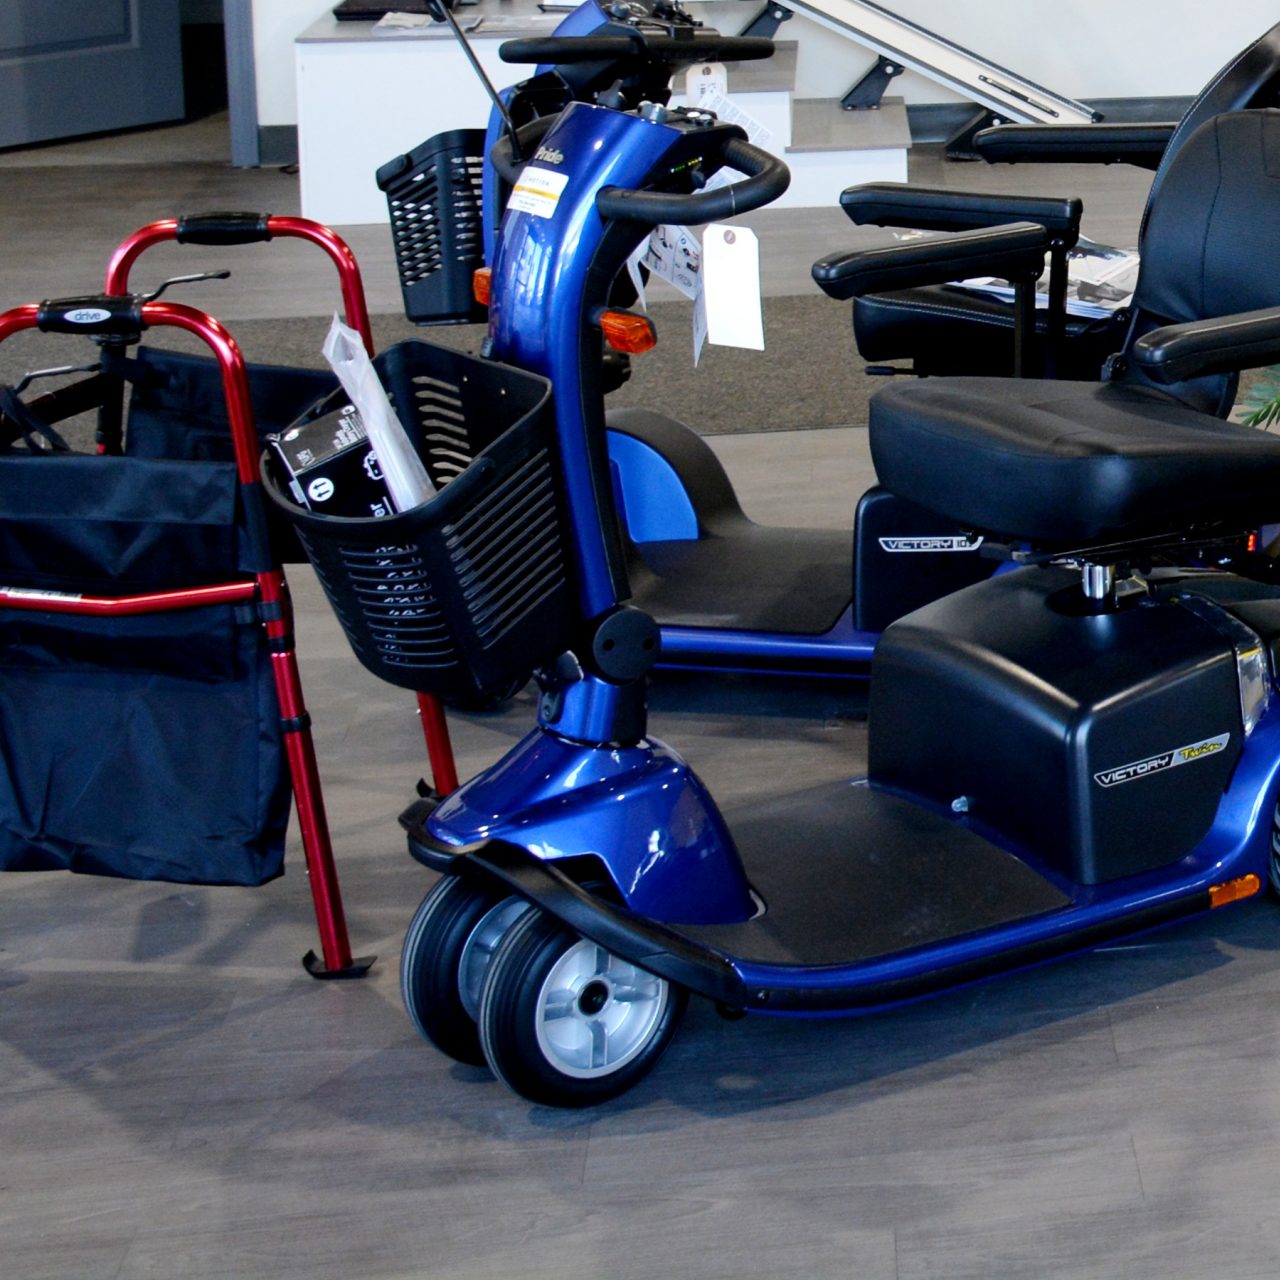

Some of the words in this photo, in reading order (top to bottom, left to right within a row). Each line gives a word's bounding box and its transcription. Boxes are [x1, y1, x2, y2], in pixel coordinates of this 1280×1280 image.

[534, 145, 565, 165] Pride
[74, 311, 101, 321] drive
[888, 540, 951, 549] VICTORY
[1101, 756, 1169, 783] VICTORY
[1178, 742, 1223, 760] Twin
